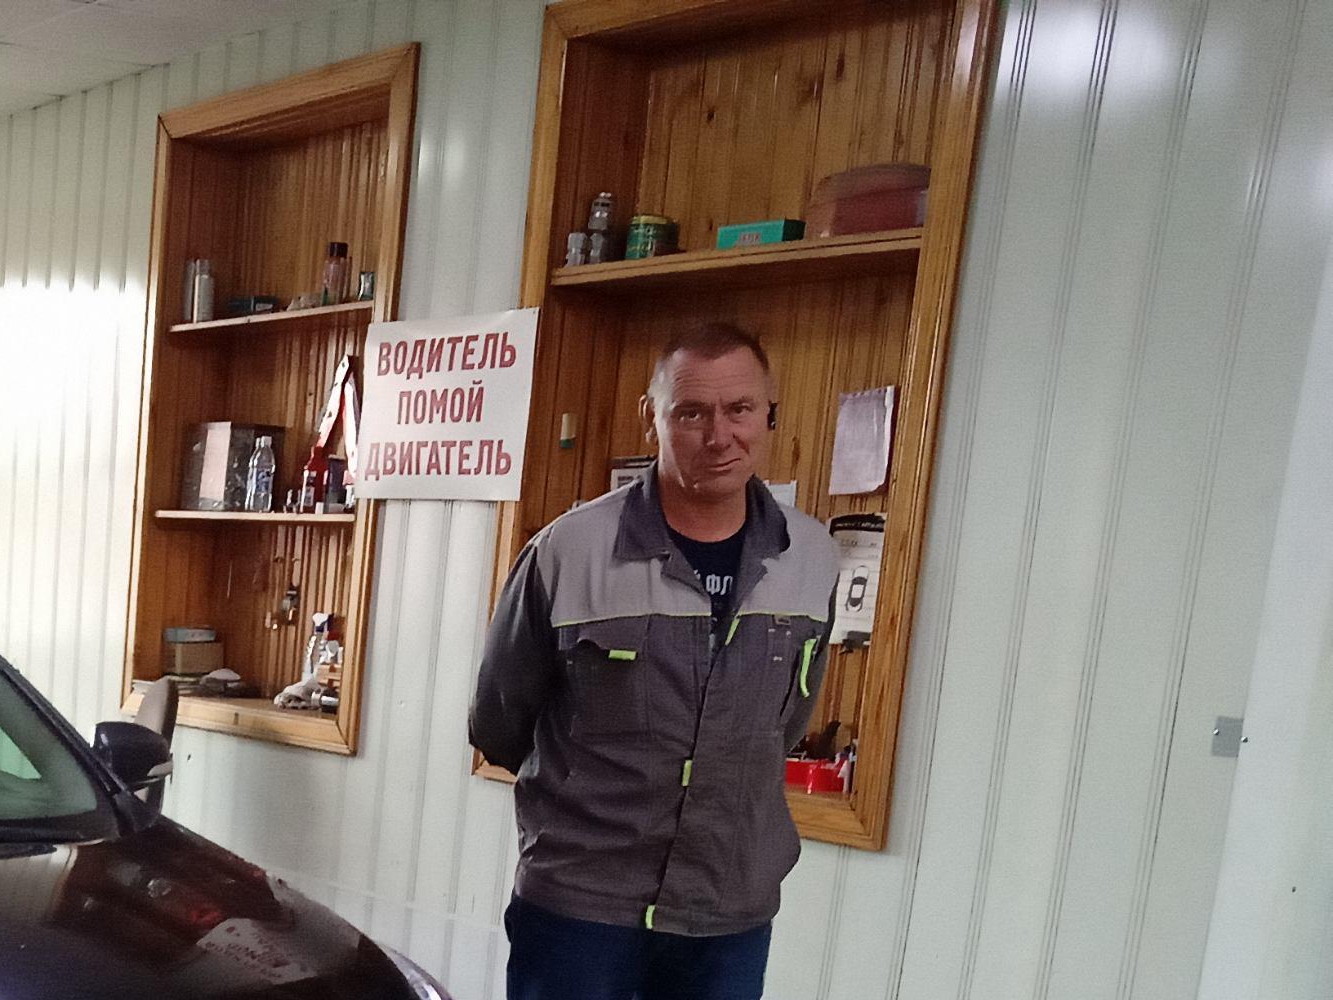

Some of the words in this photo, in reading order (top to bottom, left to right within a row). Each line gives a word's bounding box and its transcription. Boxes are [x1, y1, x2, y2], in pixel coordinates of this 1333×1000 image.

[377, 331, 517, 380] ВОДИТЕЛЬ
[396, 379, 485, 426] ПОМОЙ
[364, 439, 513, 482] ДВИГАТЕЛЬ
